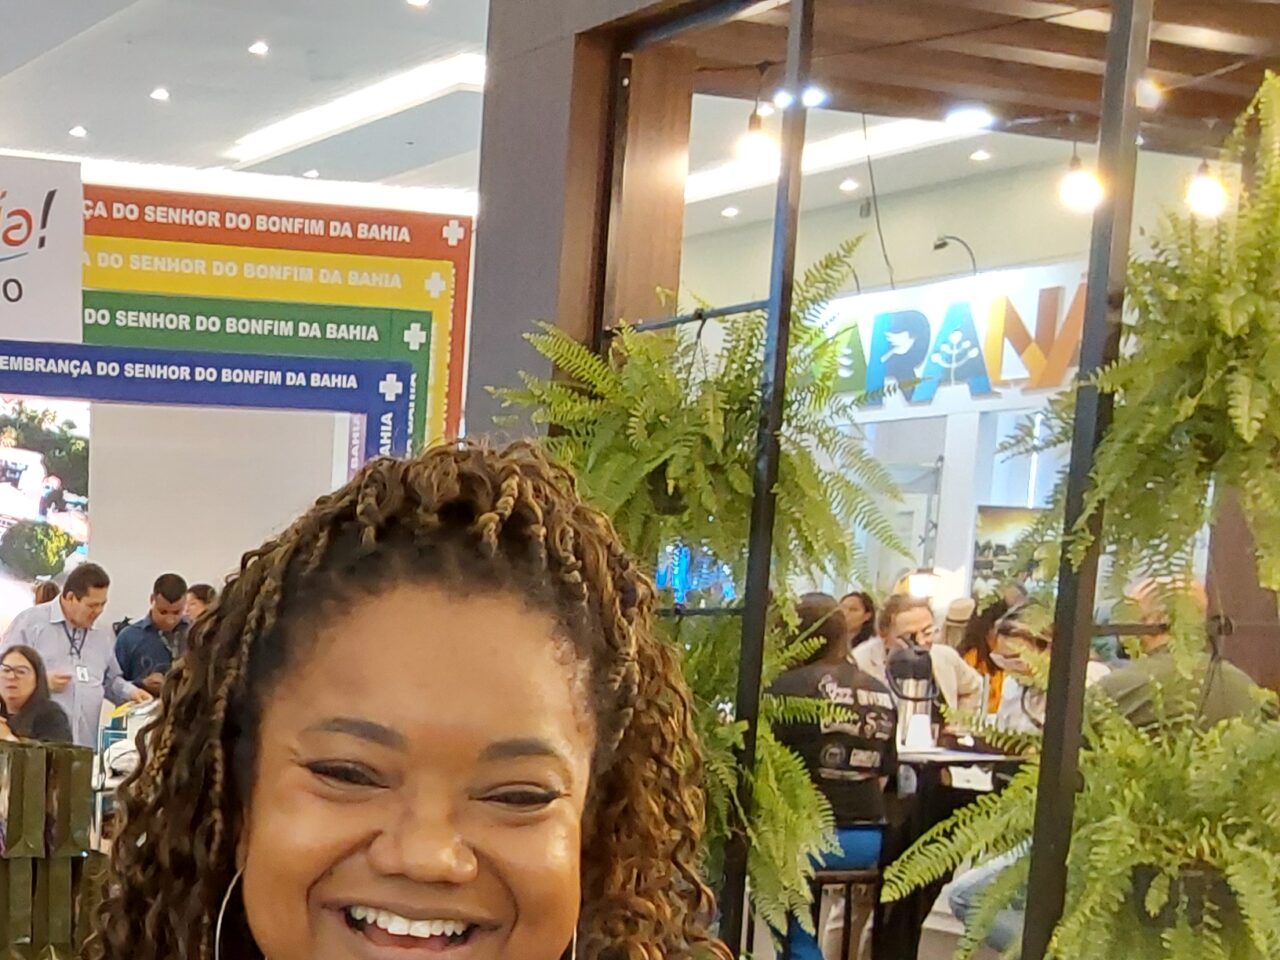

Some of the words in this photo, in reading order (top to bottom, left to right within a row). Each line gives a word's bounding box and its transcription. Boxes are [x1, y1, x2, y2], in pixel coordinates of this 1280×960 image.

[112, 202, 139, 220] DO
[144, 205, 220, 228] SENHOR
[225, 212, 251, 230] DO
[256, 214, 325, 236] BONFIM
[329, 220, 352, 238] DA
[357, 223, 411, 243] BAHIA
[97, 252, 123, 268] DO
[130, 254, 206, 275] SENHOR
[212, 260, 238, 276] DO
[243, 262, 313, 283] BONFIM
[320, 268, 342, 285] DA
[348, 270, 402, 288] BAHIA
[84, 308, 110, 325] DO
[115, 310, 190, 330] SENHOR
[195, 315, 220, 332] DO
[225, 317, 294, 337] BONFIM
[298, 321, 321, 338] DA
[325, 323, 379, 341] BAHIA
[96, 361, 120, 376] DO
[124, 363, 191, 381] SENHOR
[195, 367, 217, 382] DO
[221, 368, 282, 385] BONFIM
[285, 371, 306, 386] DA
[310, 373, 358, 389] BAHIA
[379, 411, 393, 456] AHIA
